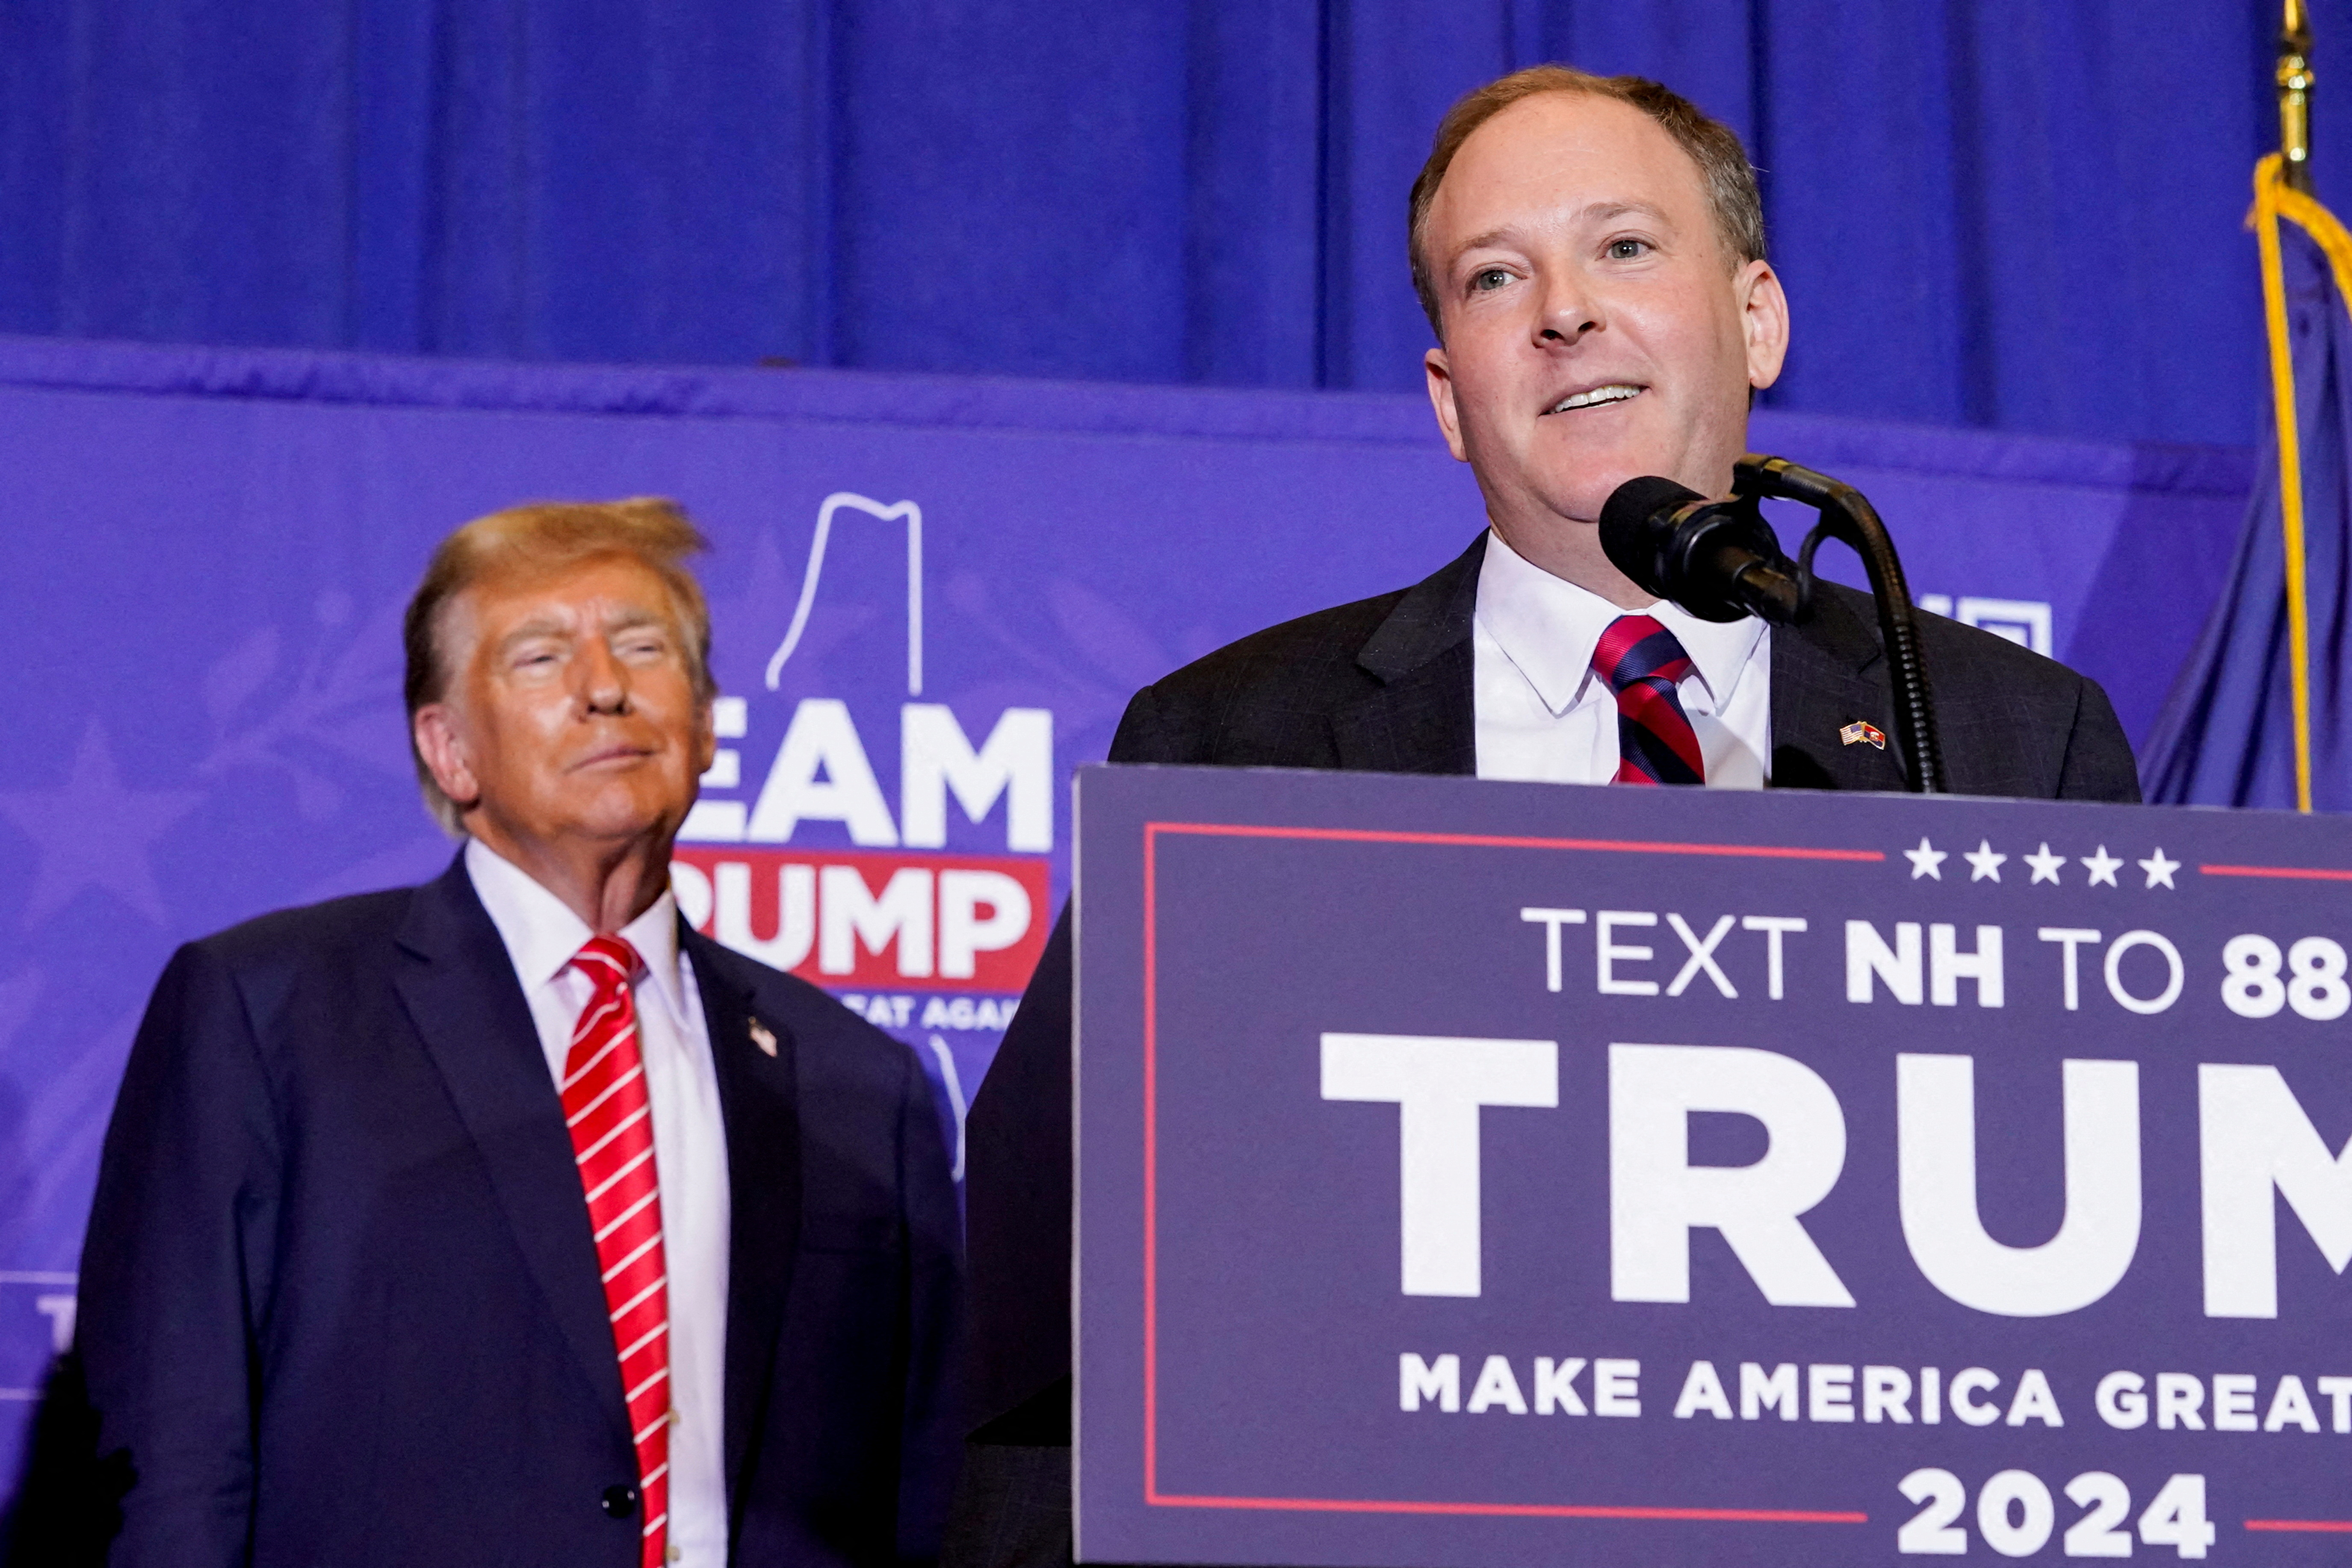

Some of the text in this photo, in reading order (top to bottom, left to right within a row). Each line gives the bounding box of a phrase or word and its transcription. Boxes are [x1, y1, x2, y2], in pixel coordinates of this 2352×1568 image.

[1520, 907, 2352, 1021] TEXT NH TO 88
[921, 997, 1020, 1031] AGAI
[1400, 1353, 2352, 1433] MAKE AMERICA GREAT
[1898, 1468, 2216, 1559] 2024
